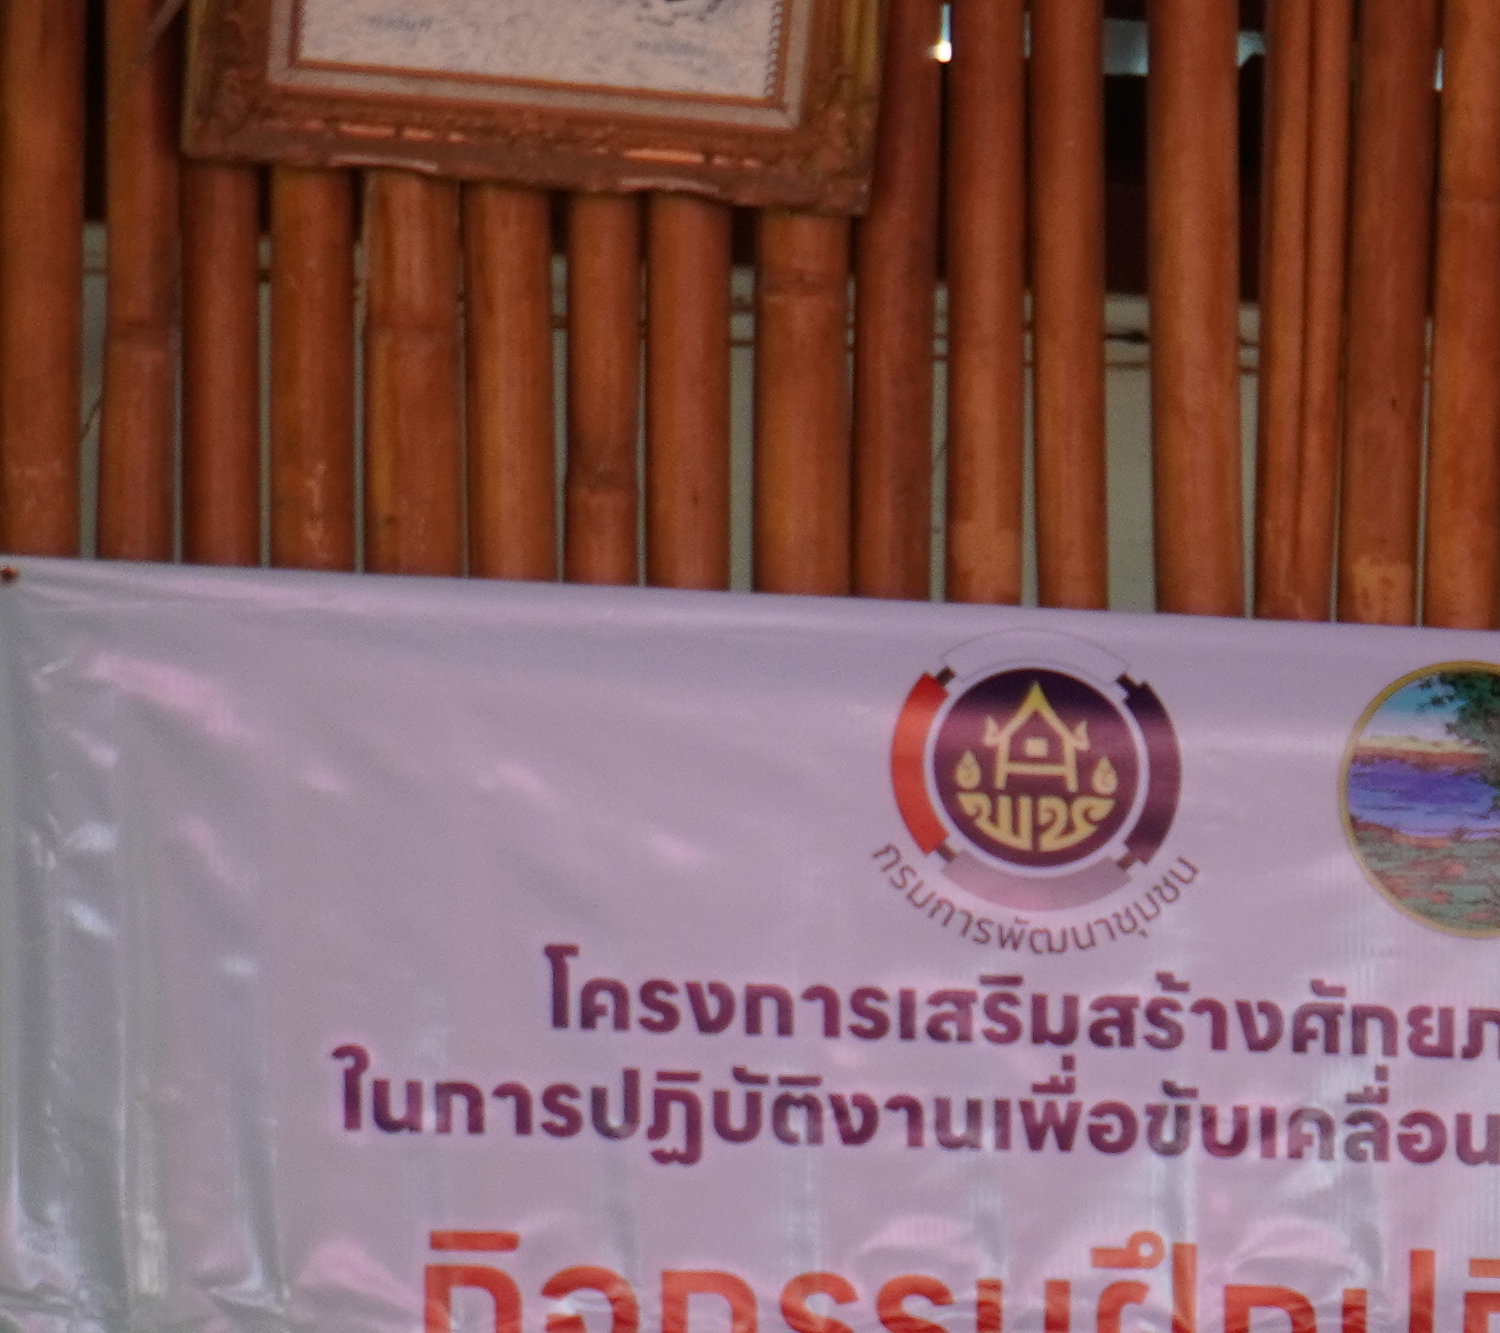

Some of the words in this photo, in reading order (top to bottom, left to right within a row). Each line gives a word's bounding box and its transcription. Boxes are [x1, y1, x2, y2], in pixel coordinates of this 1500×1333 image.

[872, 842, 1200, 954] กรมการพัฒนาชุมชน
